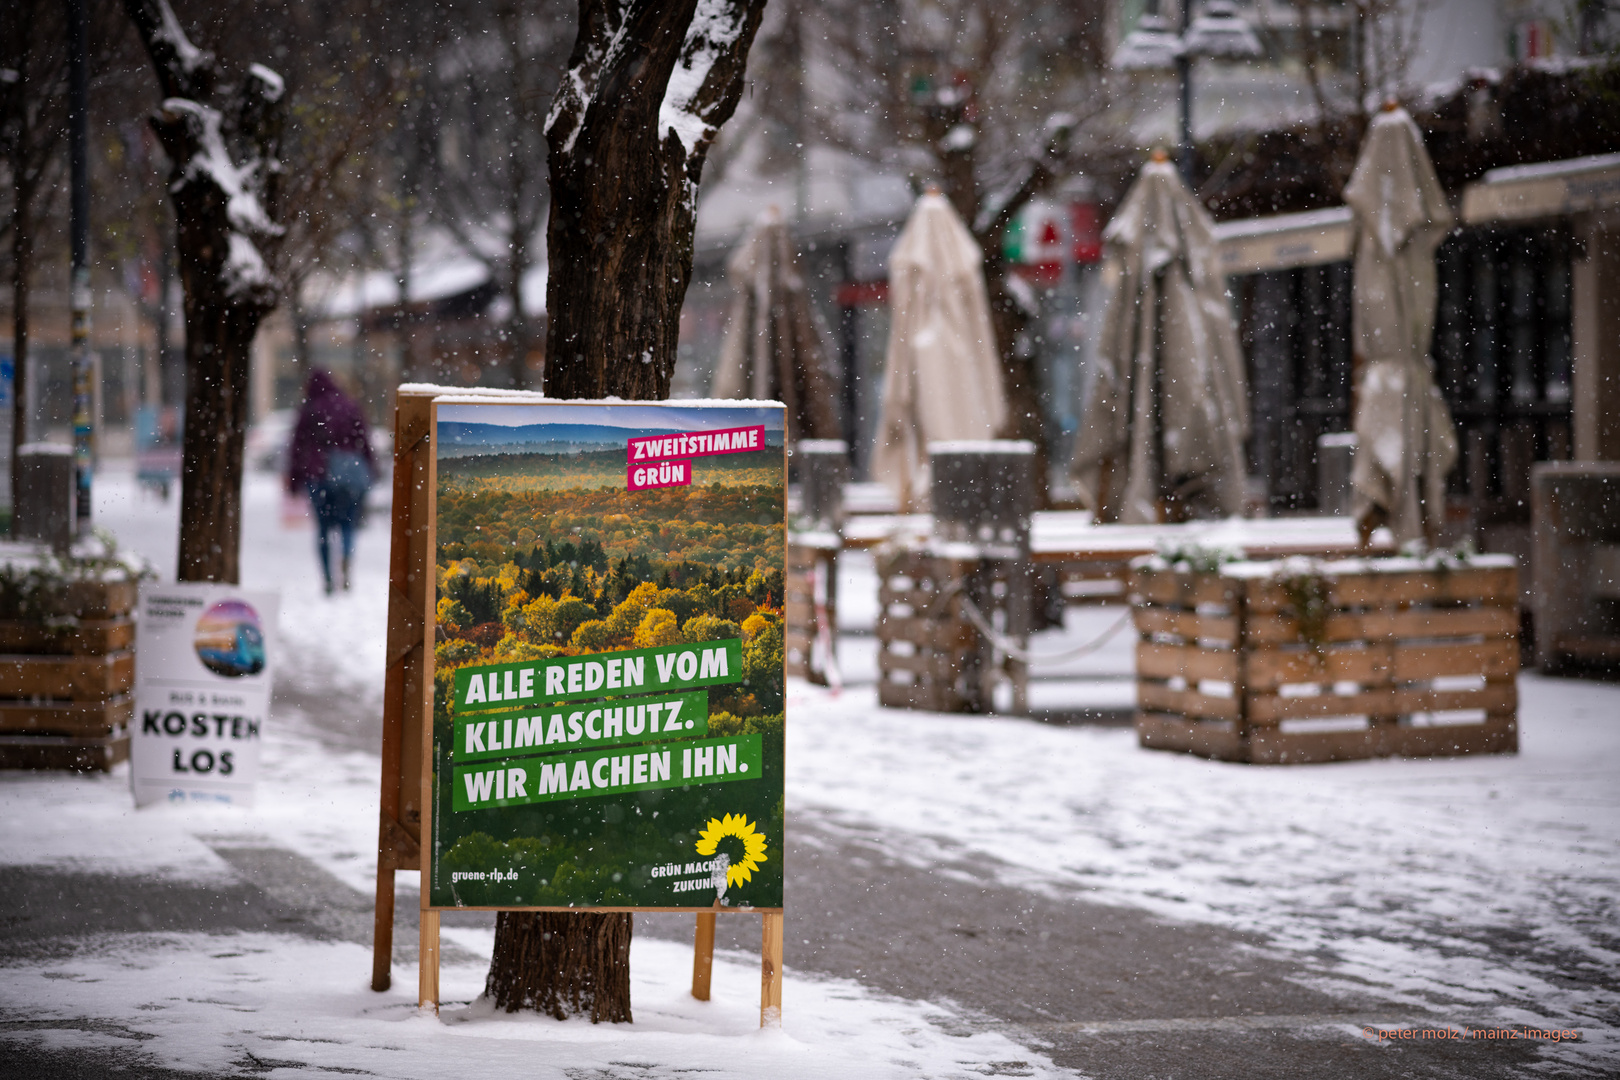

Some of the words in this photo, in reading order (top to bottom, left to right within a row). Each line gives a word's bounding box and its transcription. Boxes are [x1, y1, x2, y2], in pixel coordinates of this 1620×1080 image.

[633, 429, 758, 459] ZWEITSTIMME
[633, 461, 684, 487] GRÜN
[465, 668, 535, 704] ALLE
[545, 656, 645, 695] REDEN
[655, 647, 729, 683] VOM
[142, 709, 261, 740] KOSTEN
[465, 701, 695, 754] KLIMASCHUTZ.
[172, 748, 234, 775] LOS
[463, 768, 528, 803] WIR
[538, 751, 671, 795] MACHEN
[682, 743, 749, 779] IHN.
[452, 867, 519, 883] gruene-rlp.de
[651, 863, 682, 878] GRÜN
[672, 877, 716, 893] ZUKUN
